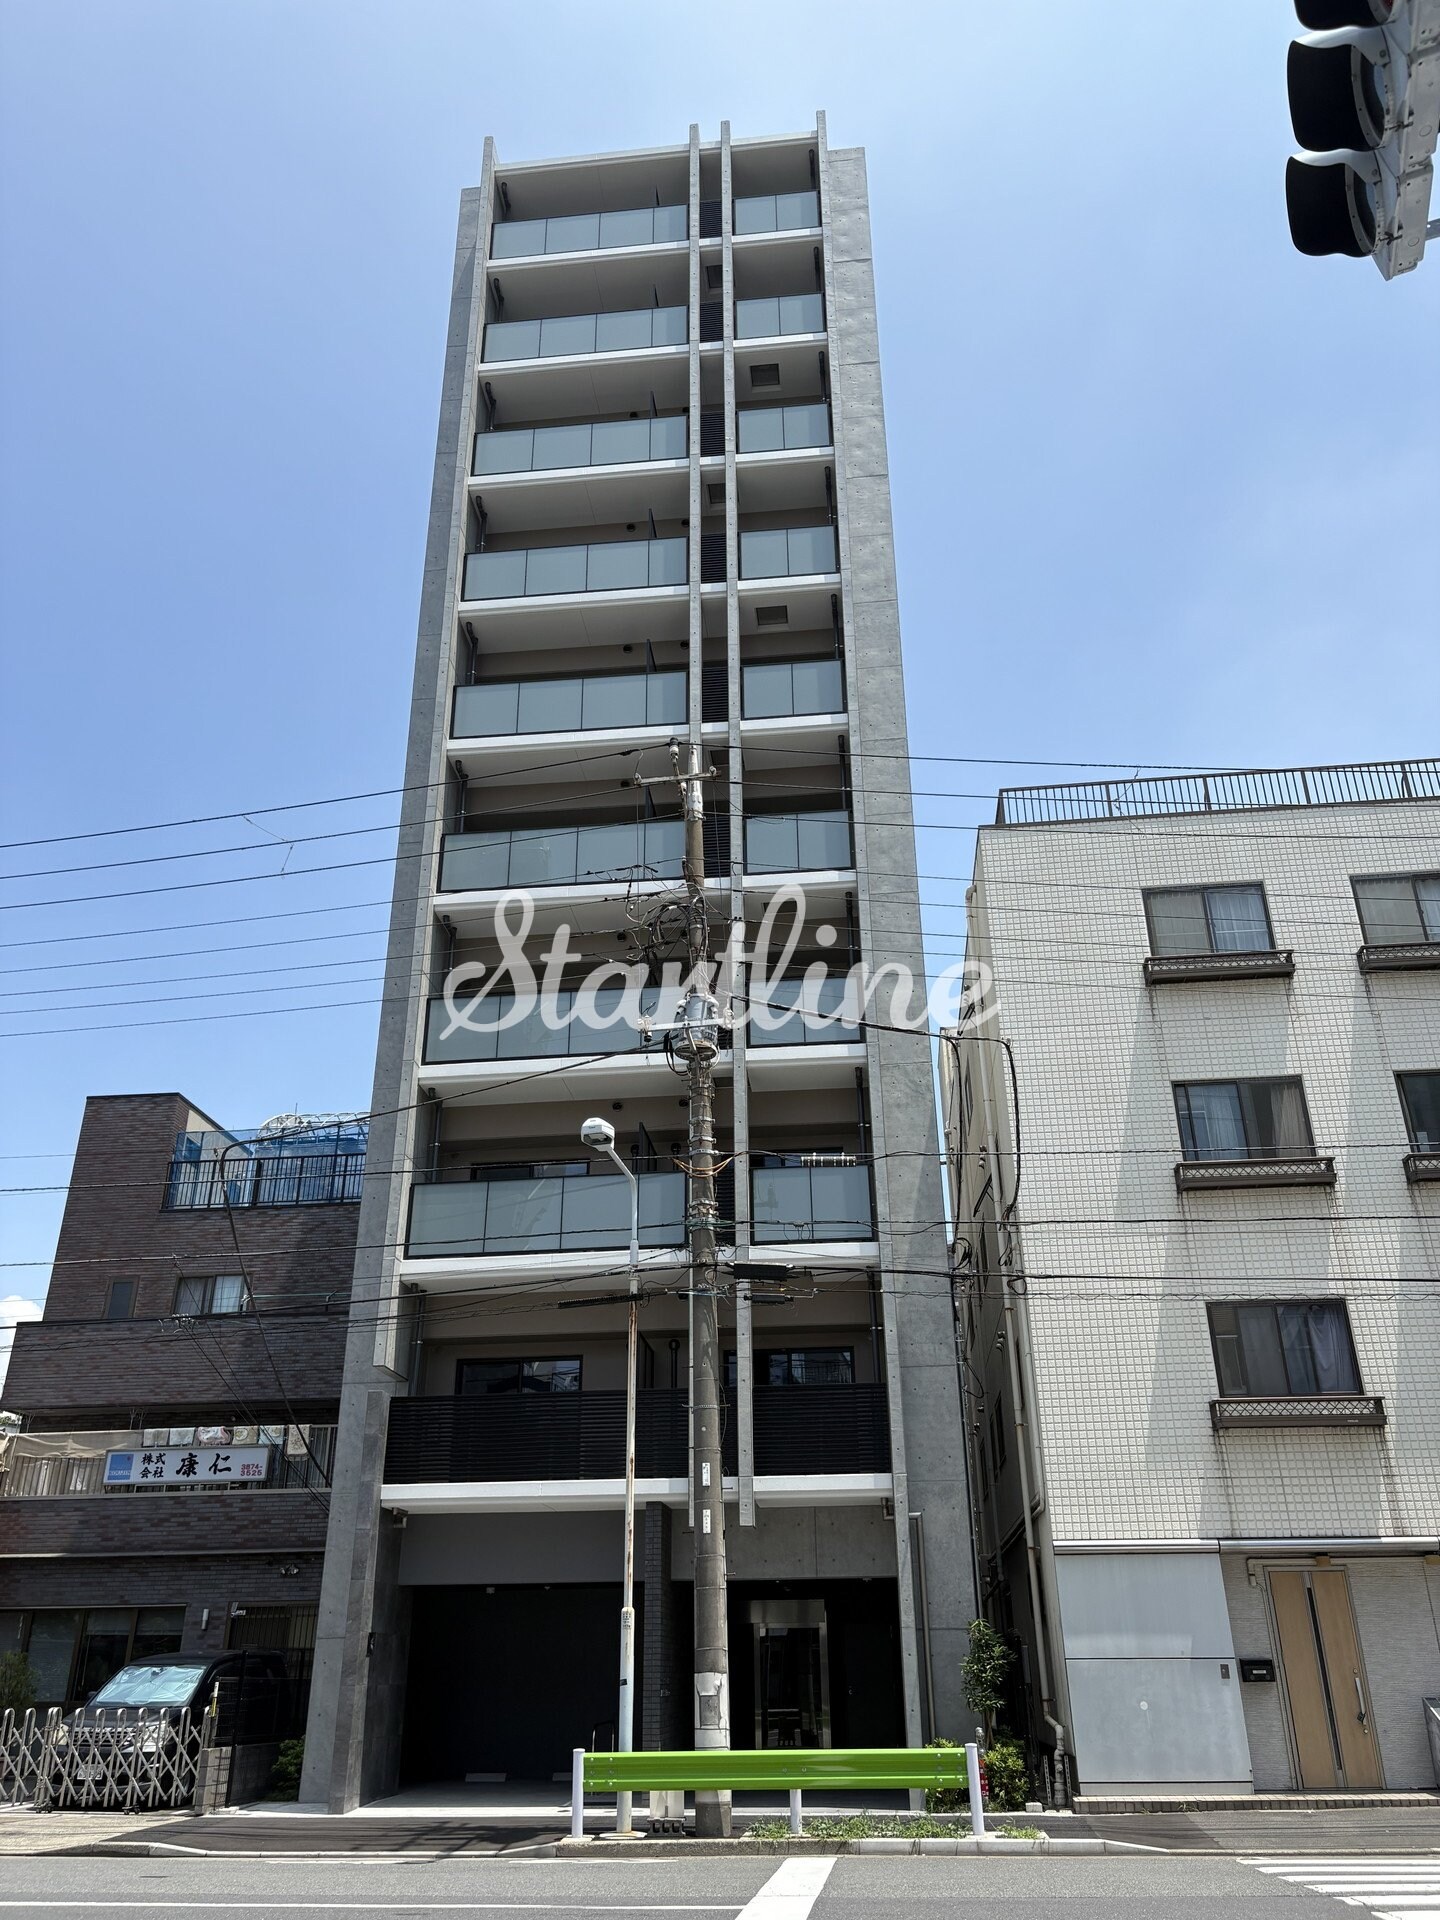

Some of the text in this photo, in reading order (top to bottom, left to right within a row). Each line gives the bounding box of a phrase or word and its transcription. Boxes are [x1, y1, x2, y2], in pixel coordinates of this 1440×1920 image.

[141, 1453, 166, 1465] 株式
[176, 1452, 232, 1477] 康仁
[140, 1467, 164, 1478] 会社
